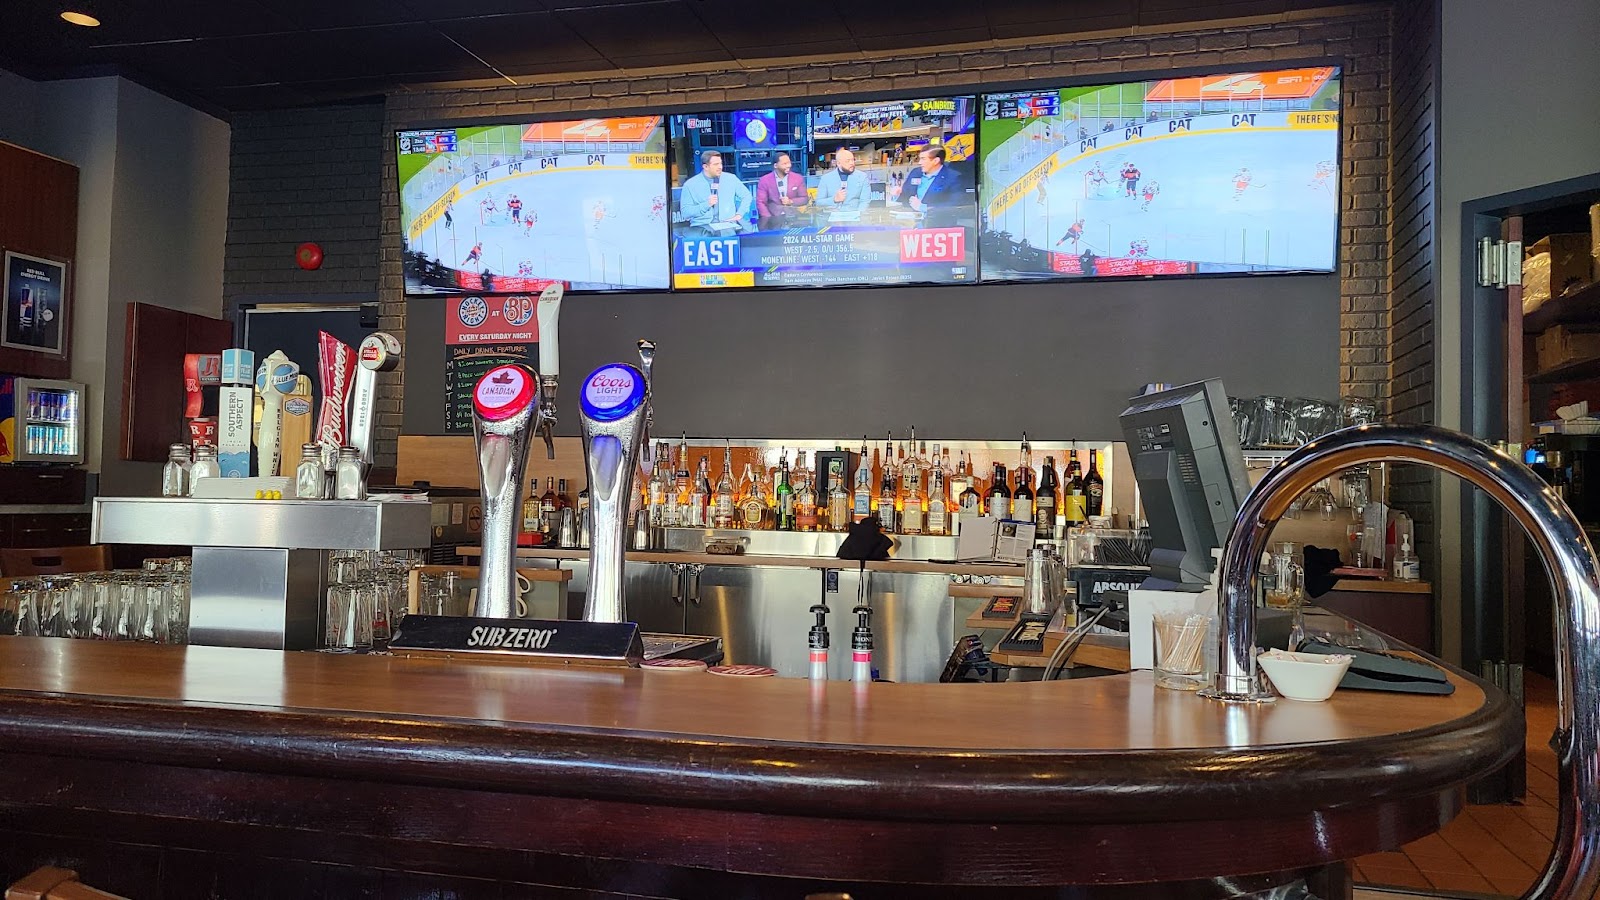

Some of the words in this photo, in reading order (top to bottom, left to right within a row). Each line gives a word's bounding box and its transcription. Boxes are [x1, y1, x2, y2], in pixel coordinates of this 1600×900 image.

[1277, 76, 1302, 84] ESPN
[1052, 97, 1059, 105] 2
[1052, 106, 1059, 115] 4
[1231, 113, 1257, 127] CAT
[1296, 114, 1330, 124] THERE'S
[1168, 118, 1193, 133] CAT
[451, 135, 457, 143] 2
[1125, 126, 1144, 141] CAT
[1080, 137, 1098, 153] CAT
[541, 157, 558, 169] CAT
[587, 154, 606, 166] CAT
[635, 155, 660, 164] THERE'S
[508, 162, 522, 175] CAT
[475, 171, 489, 185] CAT
[783, 236, 799, 244] 2024
[800, 234, 832, 244] ALL-STAR
[835, 233, 855, 242] GAME
[784, 246, 803, 254] WEST
[902, 232, 963, 259] WEST
[684, 240, 738, 267] EAST
[761, 255, 800, 265] MONEYLINE:
[801, 254, 820, 263] WEST
[844, 253, 860, 262] EAST
[862, 252, 878, 261] +118
[462, 298, 485, 311] HOCKEY
[463, 314, 484, 324] NIGHT
[453, 347, 471, 356] DAILY
[475, 347, 495, 355] DRINK
[446, 361, 454, 370] M
[446, 372, 453, 381] T
[592, 374, 632, 388] Coors
[445, 383, 454, 391] W
[482, 387, 516, 395] CANADIAN
[322, 341, 346, 449] Budweiser
[445, 391, 454, 401] T
[445, 403, 452, 411] F
[227, 391, 236, 437] SOUTHERN
[236, 398, 244, 430] ASPECT
[446, 411, 451, 420] S
[446, 421, 451, 429] S
[270, 451, 278, 477] WHIT
